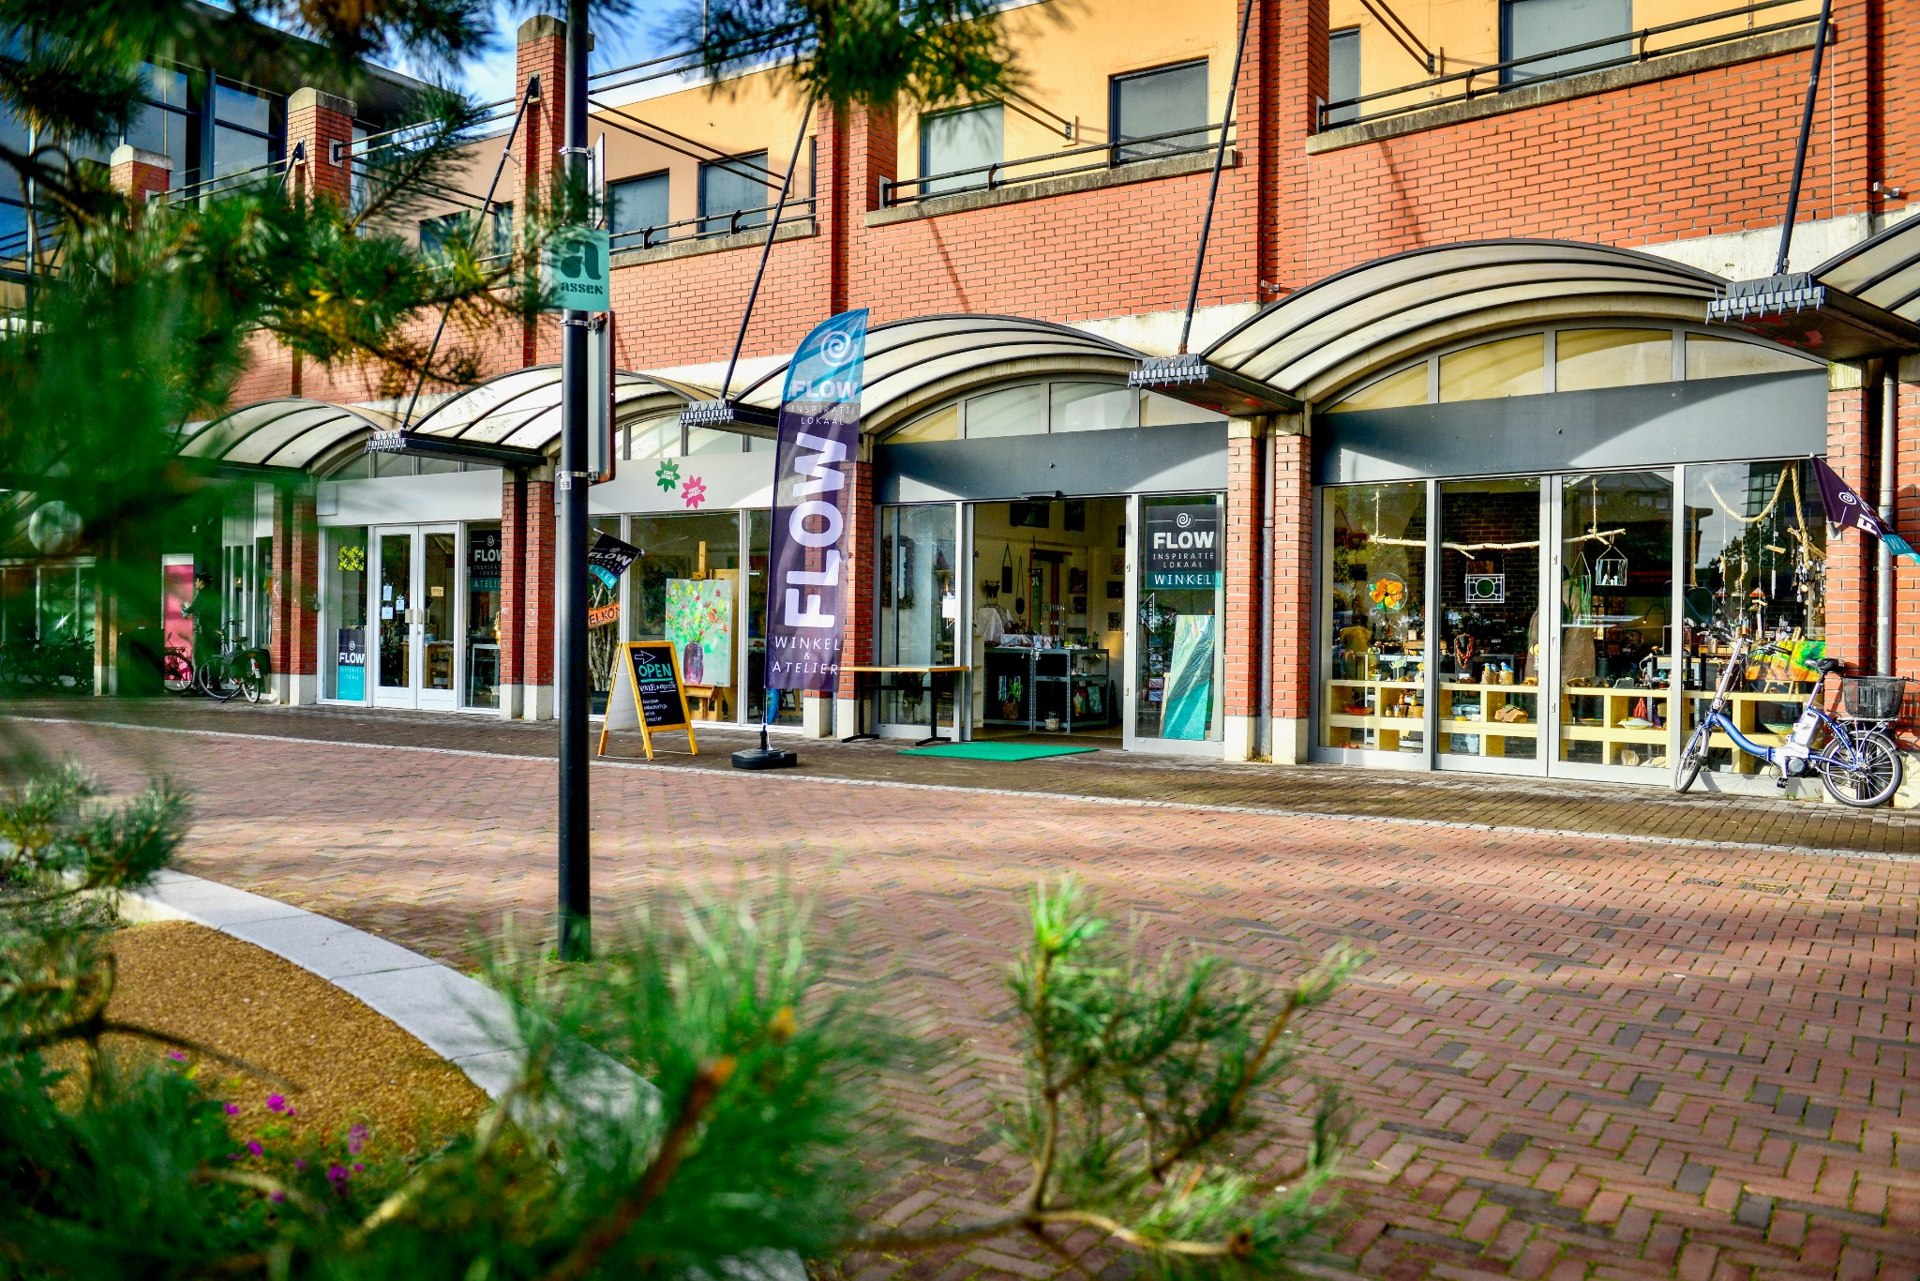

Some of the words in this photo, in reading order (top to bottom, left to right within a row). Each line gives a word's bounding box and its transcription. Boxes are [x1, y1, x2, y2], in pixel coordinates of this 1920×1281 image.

[560, 282, 603, 295] assen
[791, 381, 859, 399] FLOW
[791, 404, 856, 415] INSPIRATIE
[801, 417, 844, 425] LOKAAL
[784, 432, 847, 628] FLOW
[1153, 531, 1215, 549] FLOW
[588, 552, 632, 567] FLOW
[1153, 551, 1214, 560] INSPIRATIE
[474, 580, 501, 588] ATELIE
[1154, 574, 1212, 585] WINKEL
[589, 607, 620, 625] ELKO
[775, 636, 841, 651] WINKEL
[339, 652, 365, 664] FLOW
[803, 652, 811, 660] &
[638, 663, 673, 677] OPEN
[772, 661, 839, 676] ATELIER
